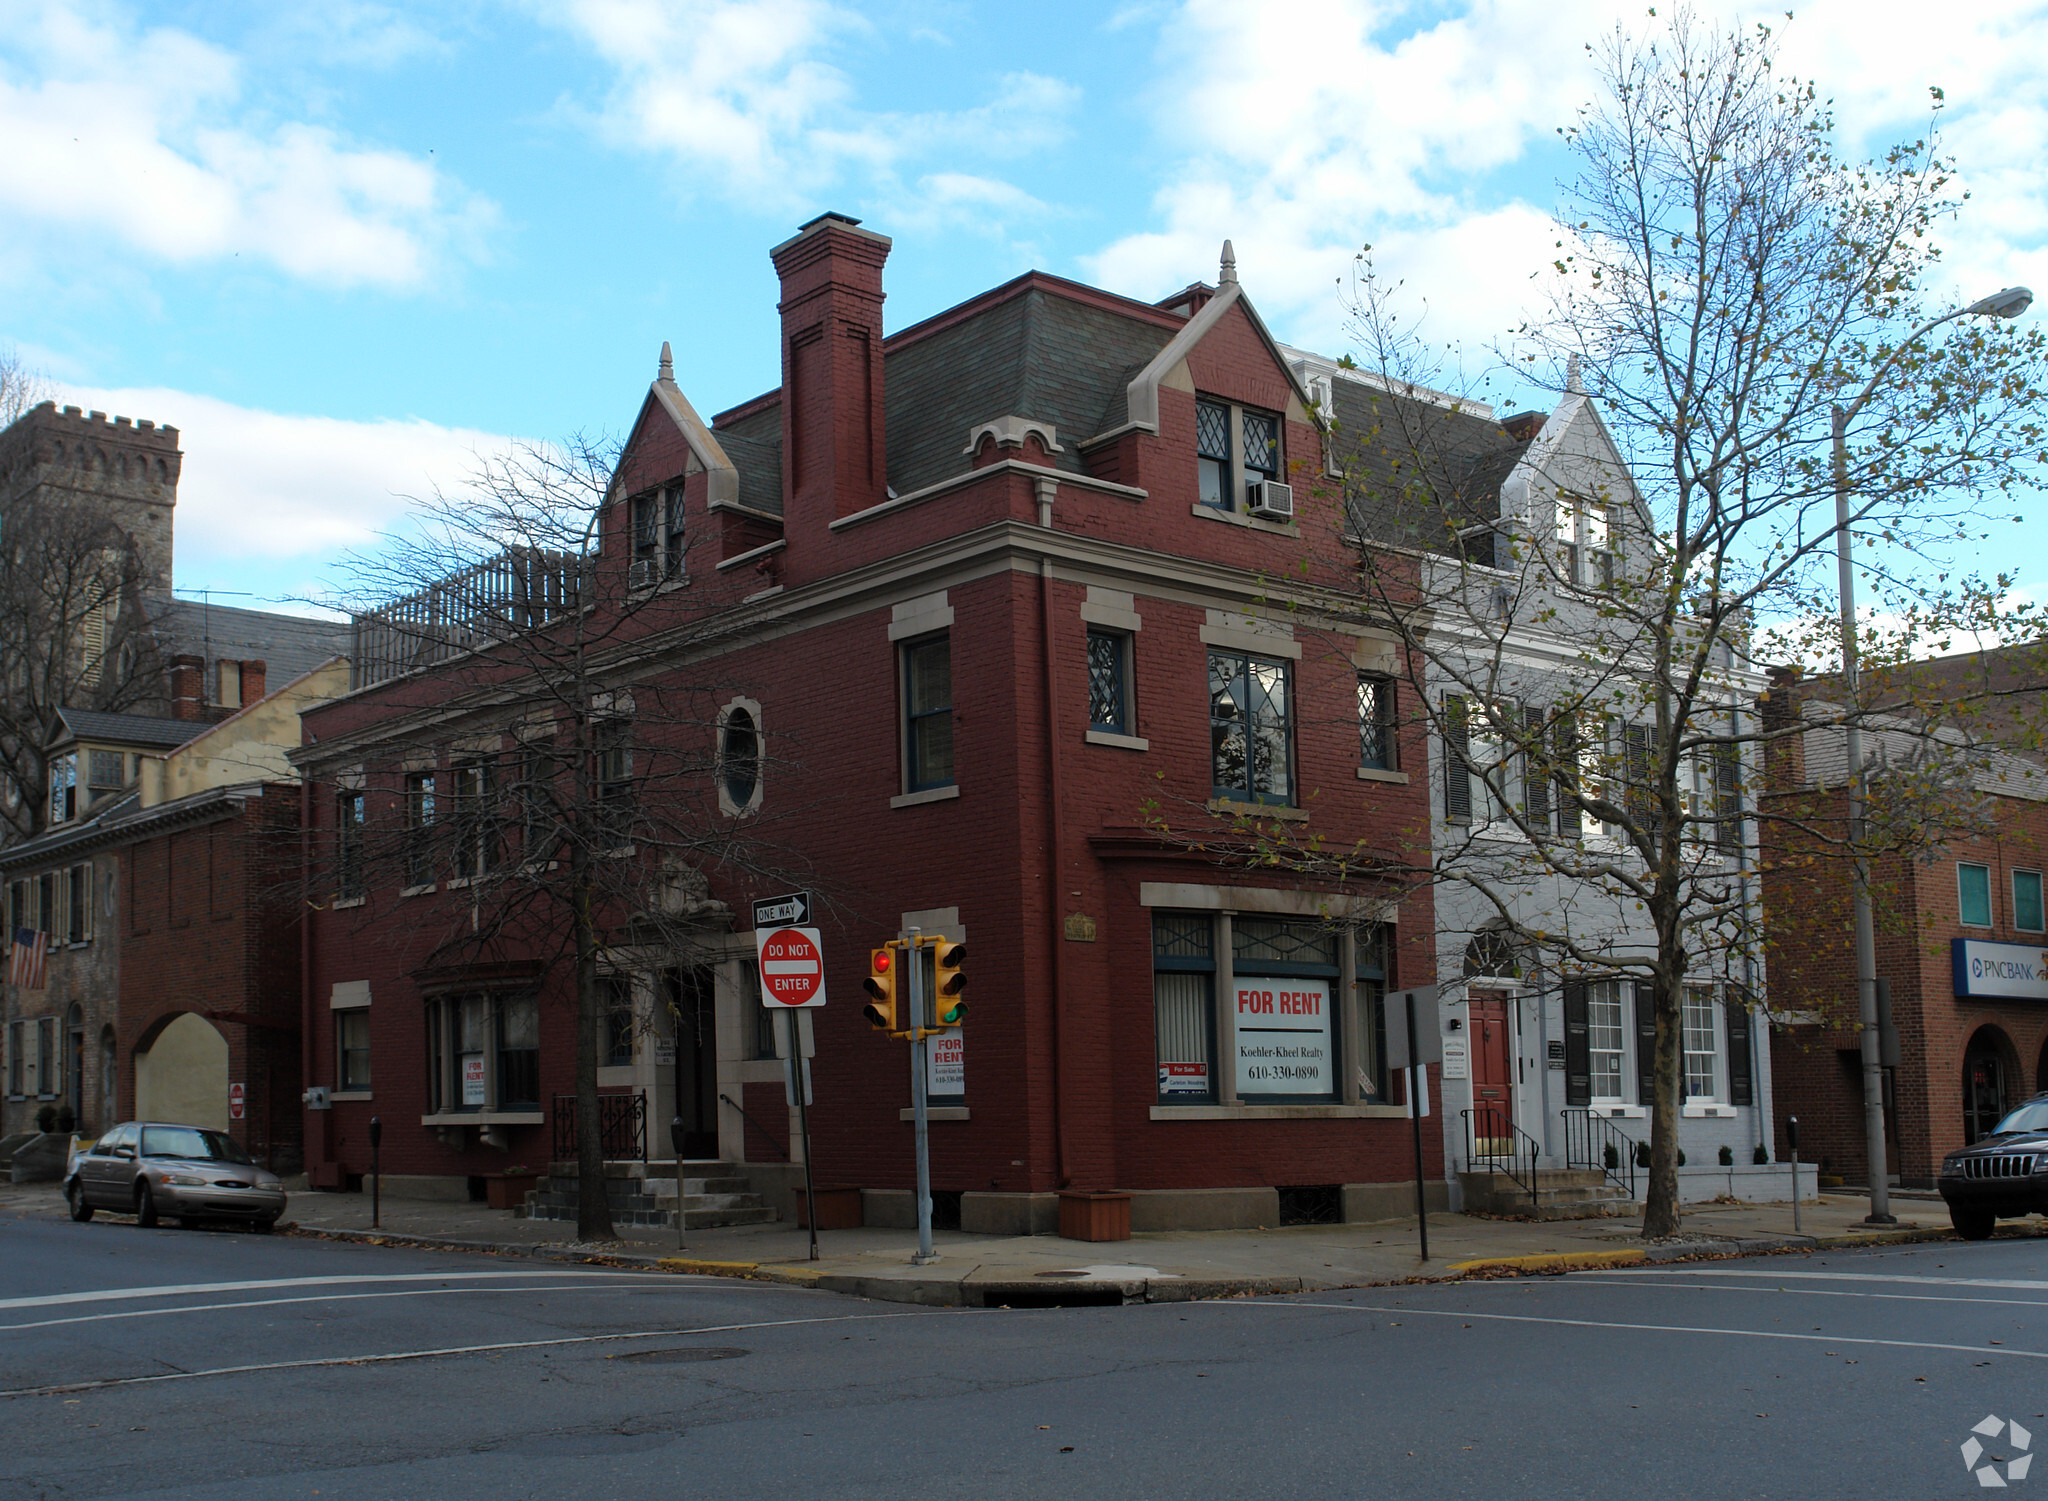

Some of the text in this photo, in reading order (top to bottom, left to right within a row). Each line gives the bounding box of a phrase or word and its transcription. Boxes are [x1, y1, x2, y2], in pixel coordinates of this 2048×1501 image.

[758, 904, 796, 921] ONE WAY
[768, 944, 810, 957] DO NOT
[774, 978, 810, 991] ENTER
[1238, 990, 1322, 1015] FOR RENT
[938, 1039, 962, 1050] FOR
[1240, 1046, 1323, 1061] Koehler-Kheel Realty
[468, 1062, 482, 1071] FOR
[1248, 1065, 1319, 1080] 610-330-0890
[466, 1072, 484, 1081] RENT
